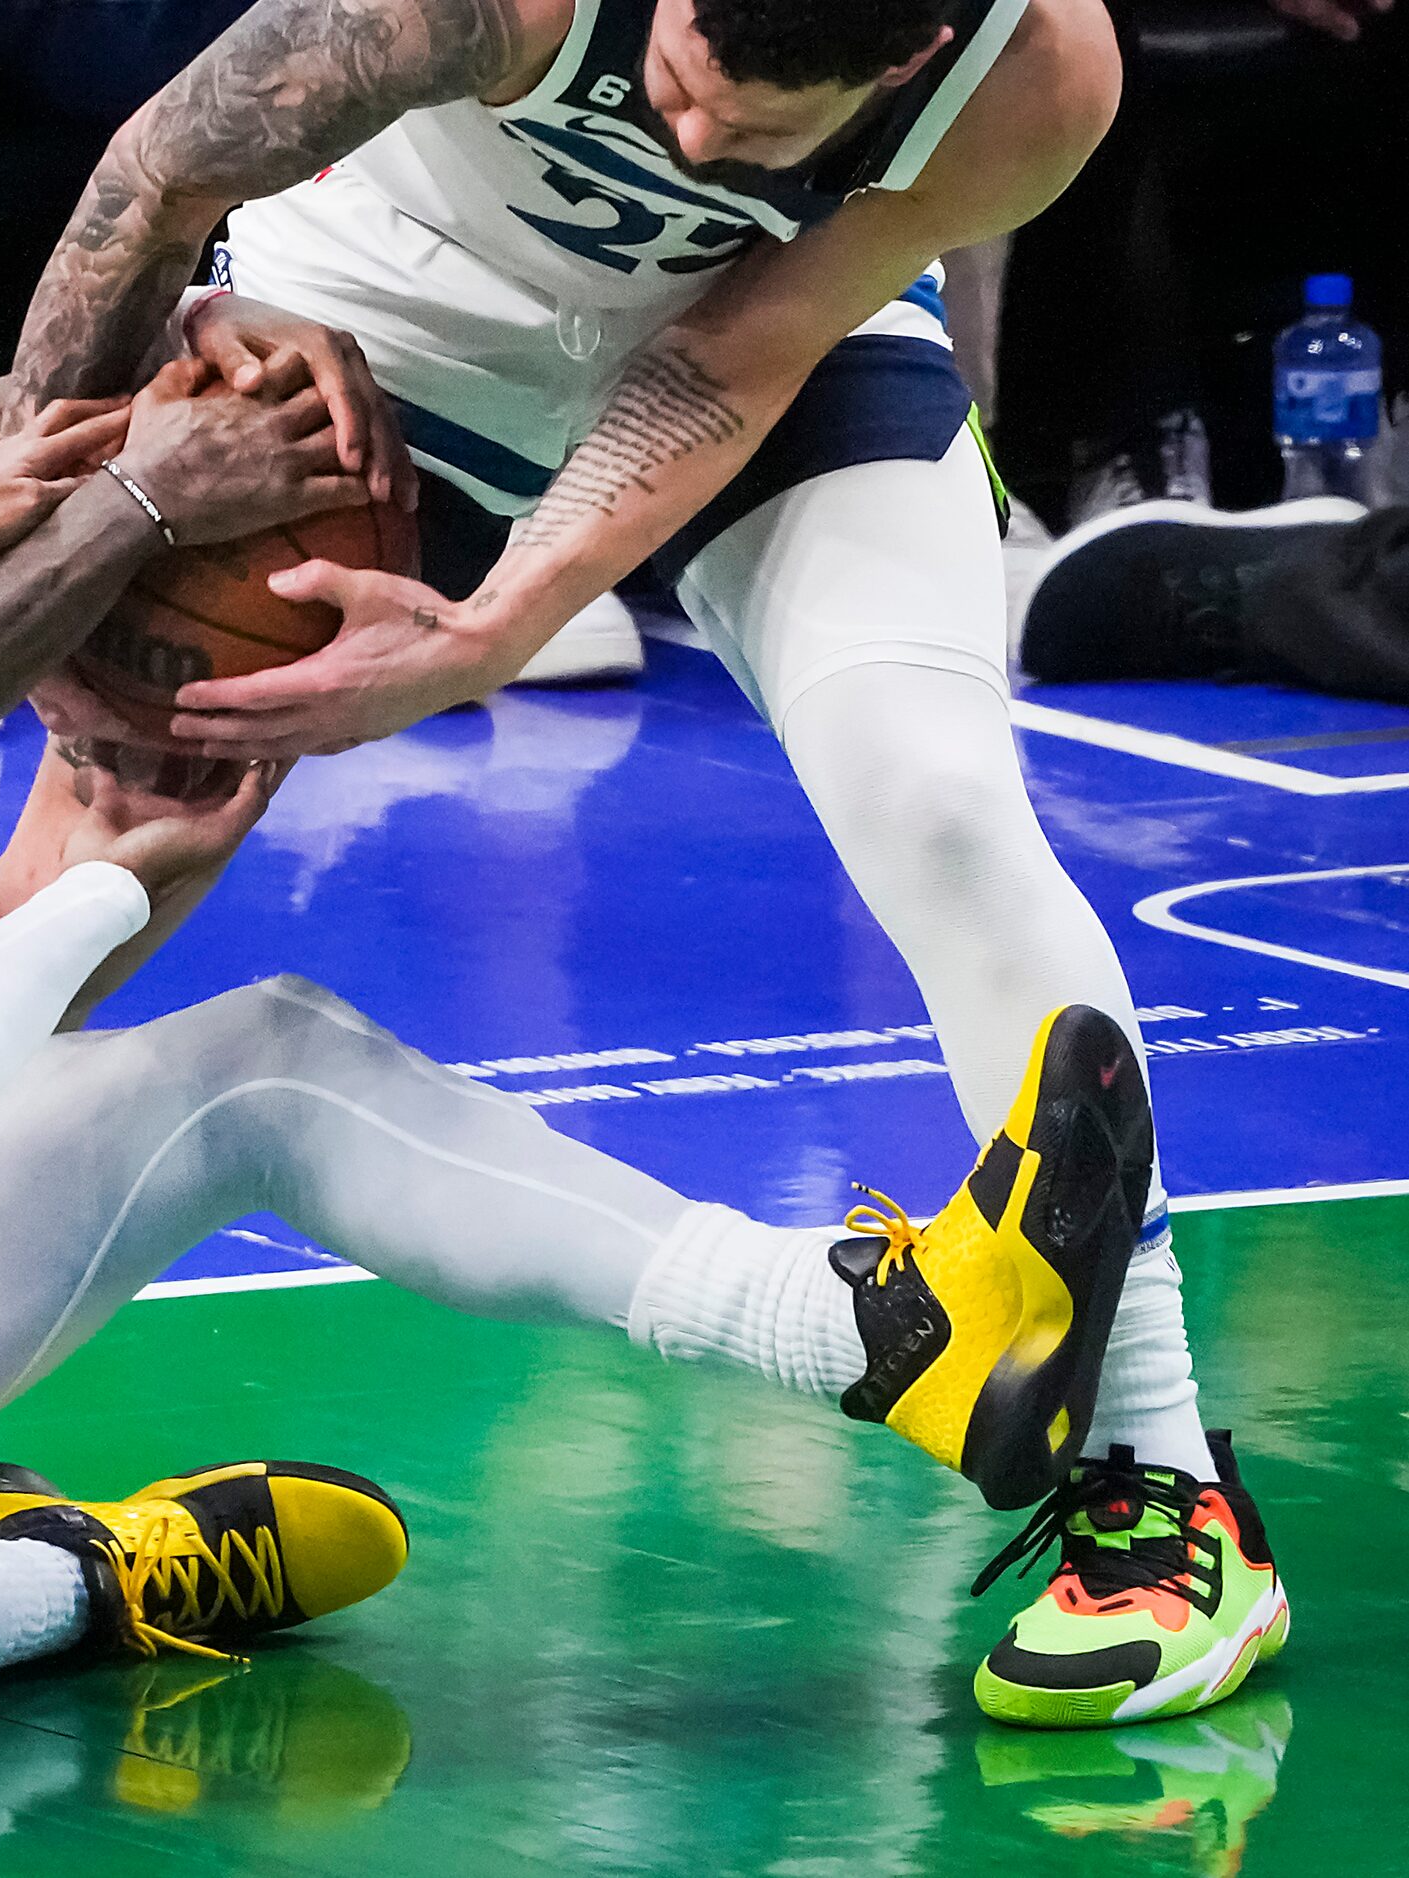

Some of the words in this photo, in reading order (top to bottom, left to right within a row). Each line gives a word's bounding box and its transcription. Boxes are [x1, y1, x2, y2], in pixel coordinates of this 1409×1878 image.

[588, 74, 632, 108] 6
[1144, 1037, 1229, 1056] TYL
[1217, 1025, 1367, 1048] TERRY
